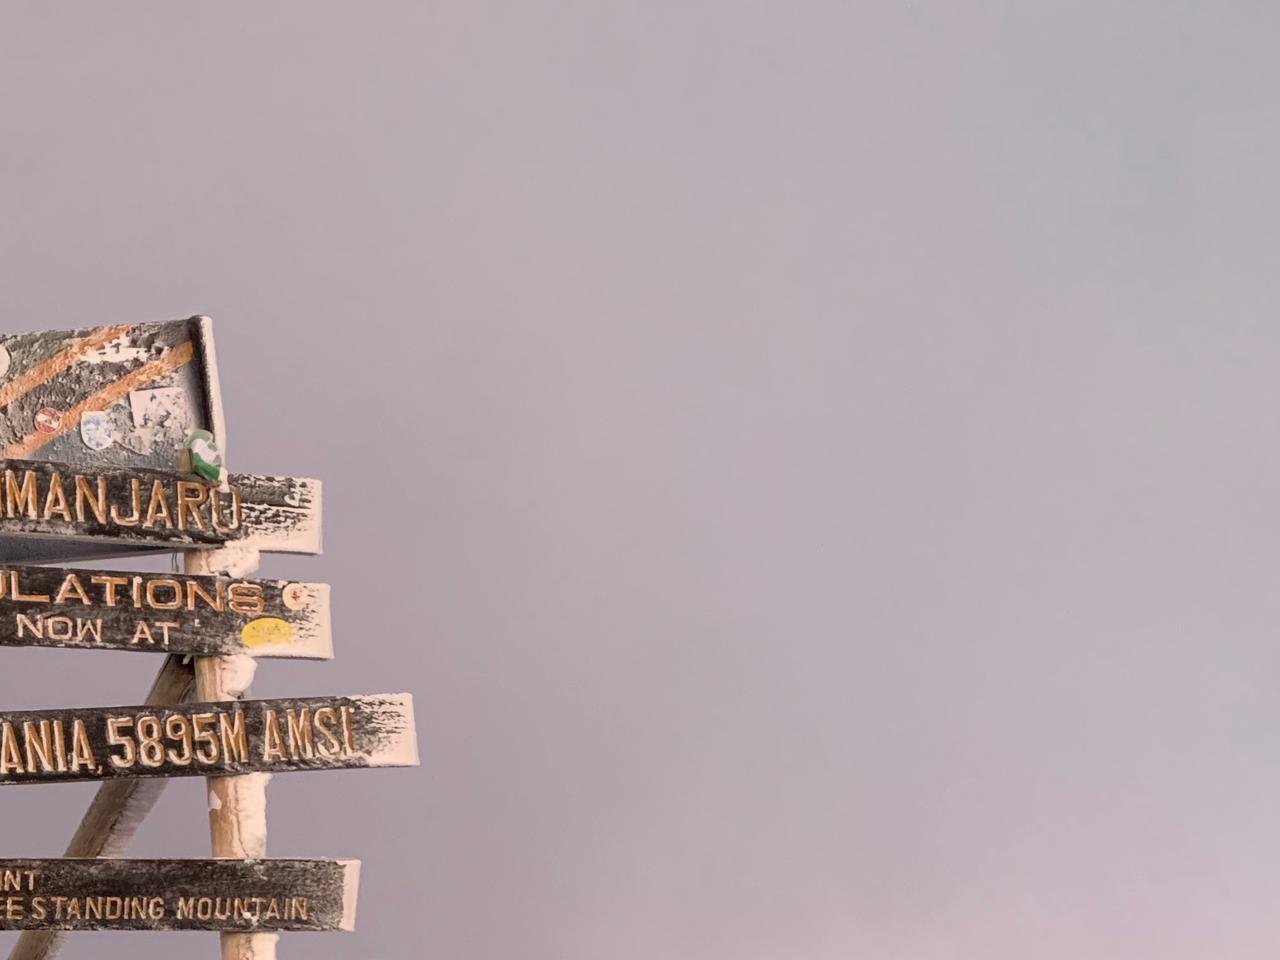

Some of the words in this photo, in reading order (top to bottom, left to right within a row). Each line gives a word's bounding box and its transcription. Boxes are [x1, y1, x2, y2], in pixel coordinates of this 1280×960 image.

[17, 613, 103, 643] NOW
[131, 619, 181, 646] AT
[106, 709, 249, 768] 5895M
[31, 896, 165, 921] STANDING
[176, 896, 309, 922] MOUNTAIN
